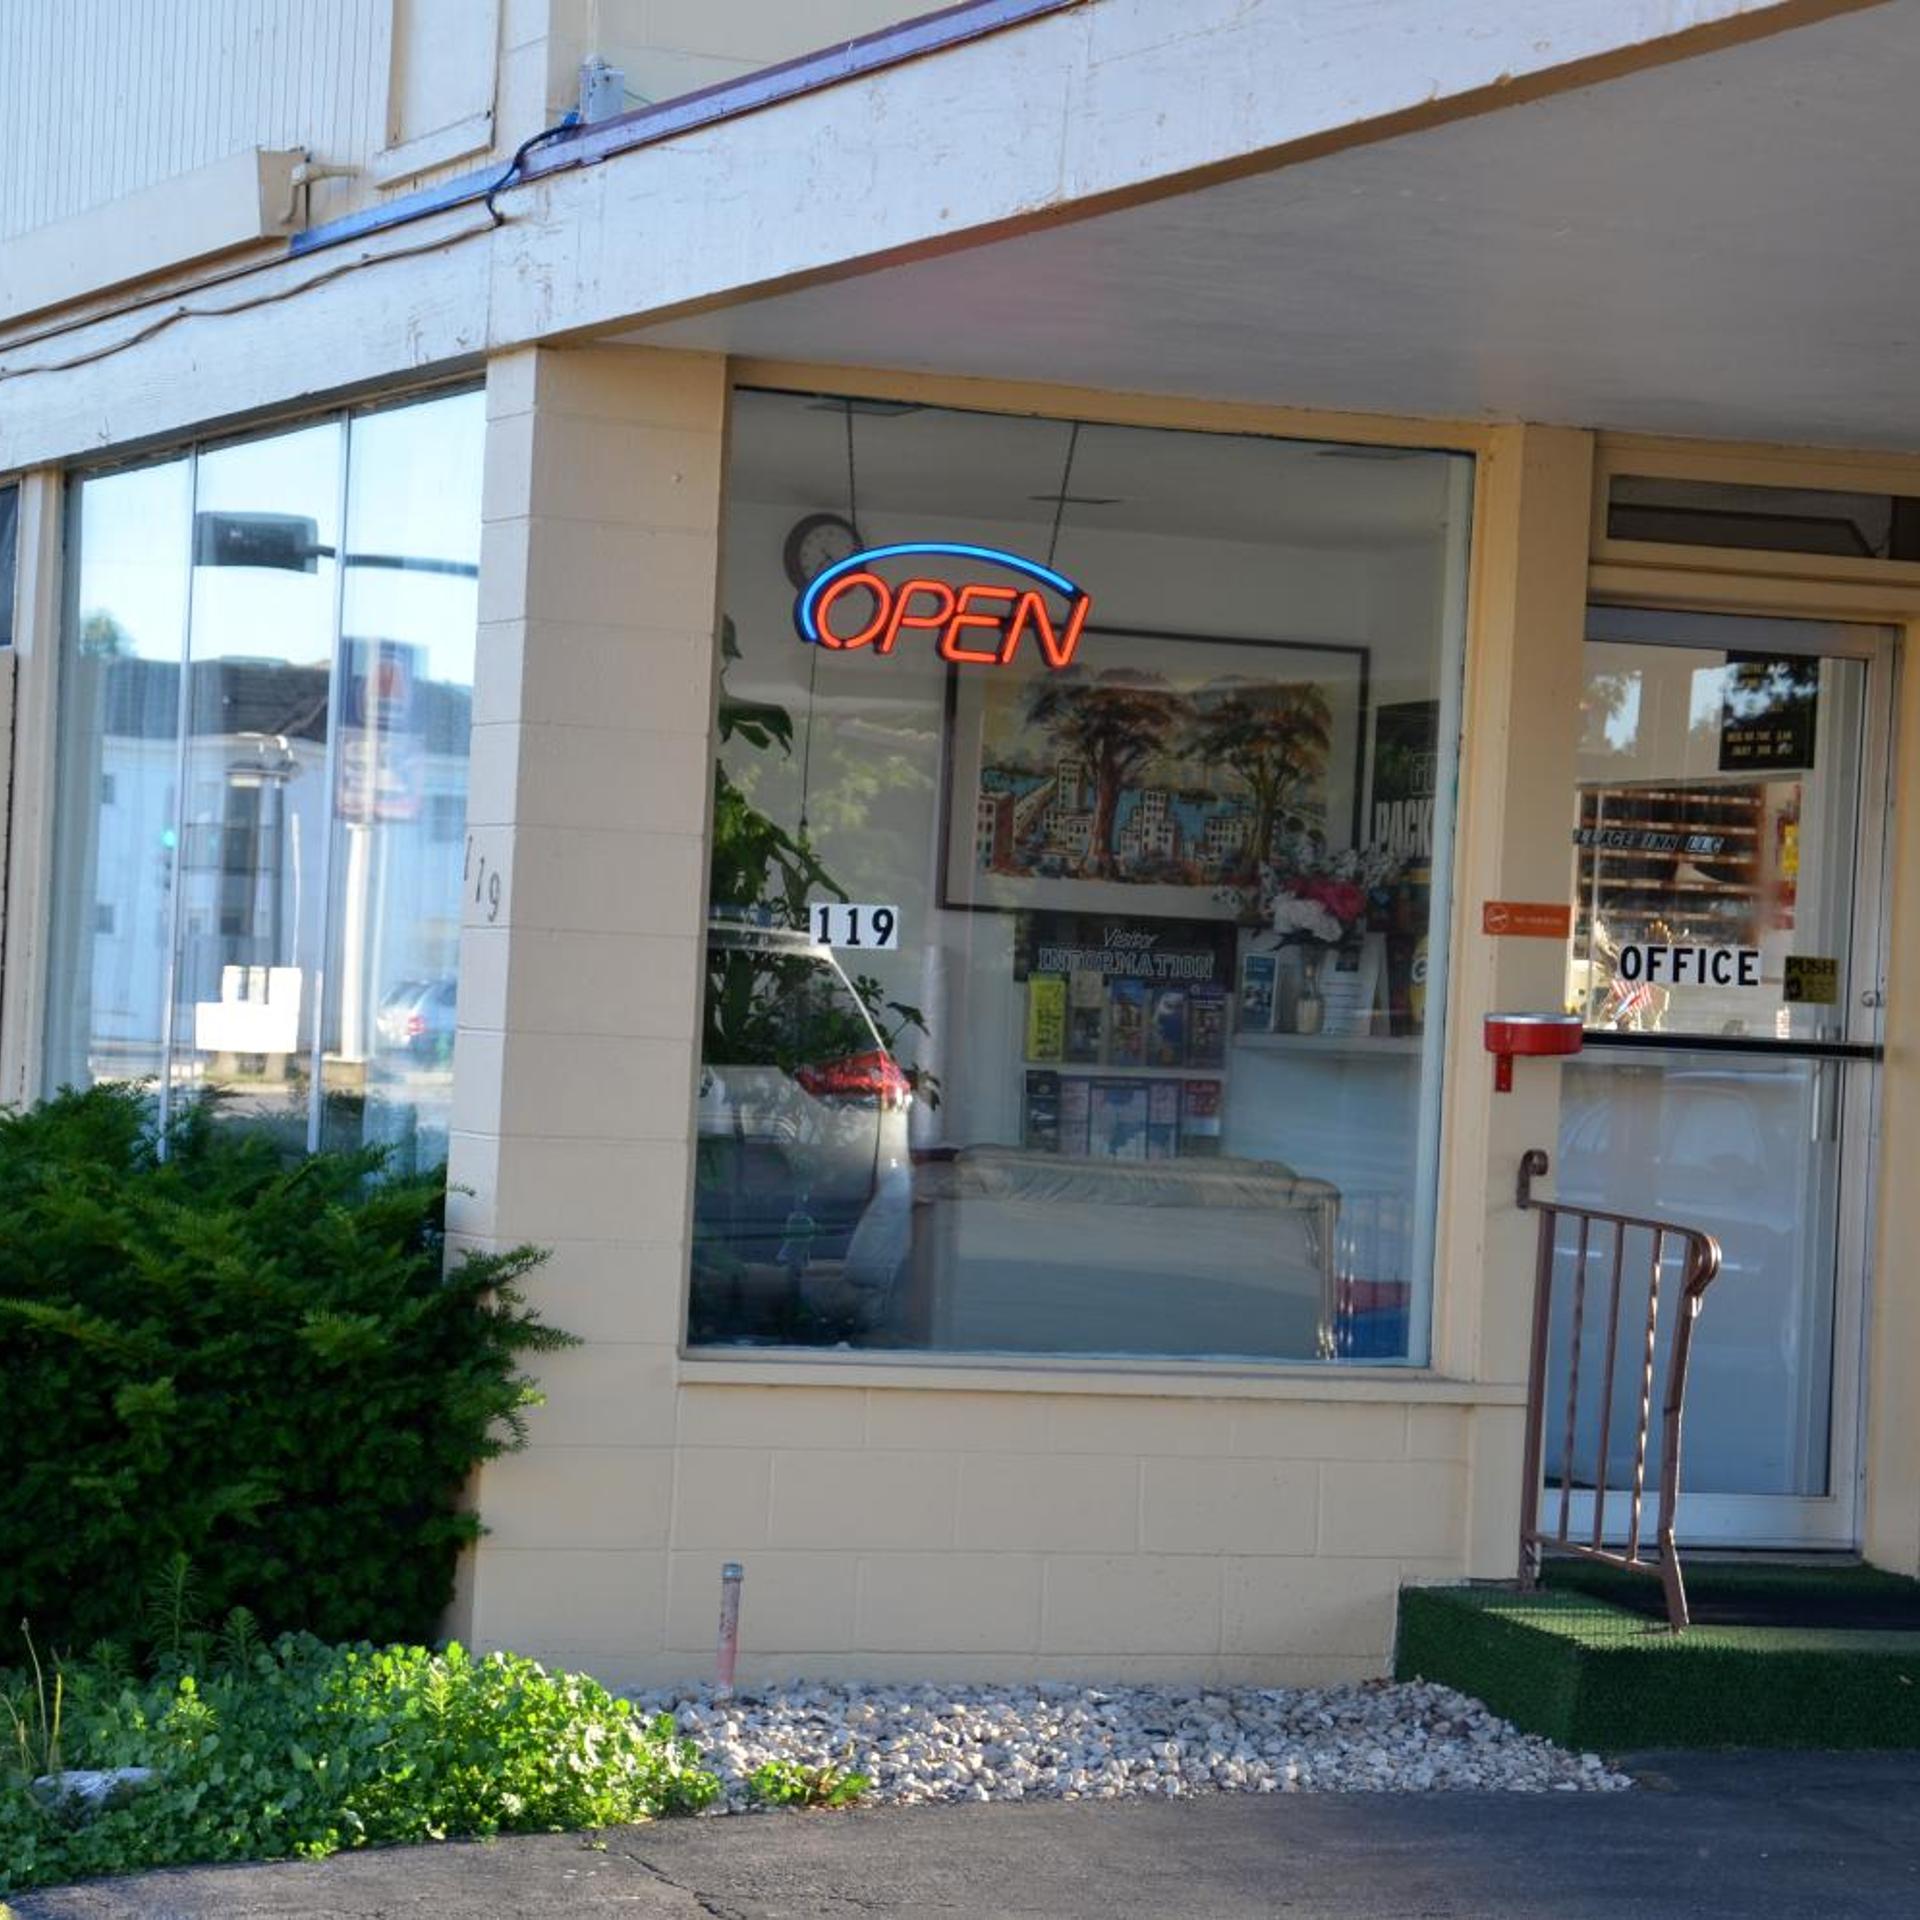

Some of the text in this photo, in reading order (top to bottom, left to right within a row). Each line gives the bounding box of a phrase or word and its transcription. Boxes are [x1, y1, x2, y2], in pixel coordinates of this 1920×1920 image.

[815, 571, 1091, 668] OPEN
[463, 834, 501, 922] 119
[817, 906, 894, 945] 119
[1620, 945, 1759, 986] OFFICE
[1788, 957, 1836, 975] PUSH
